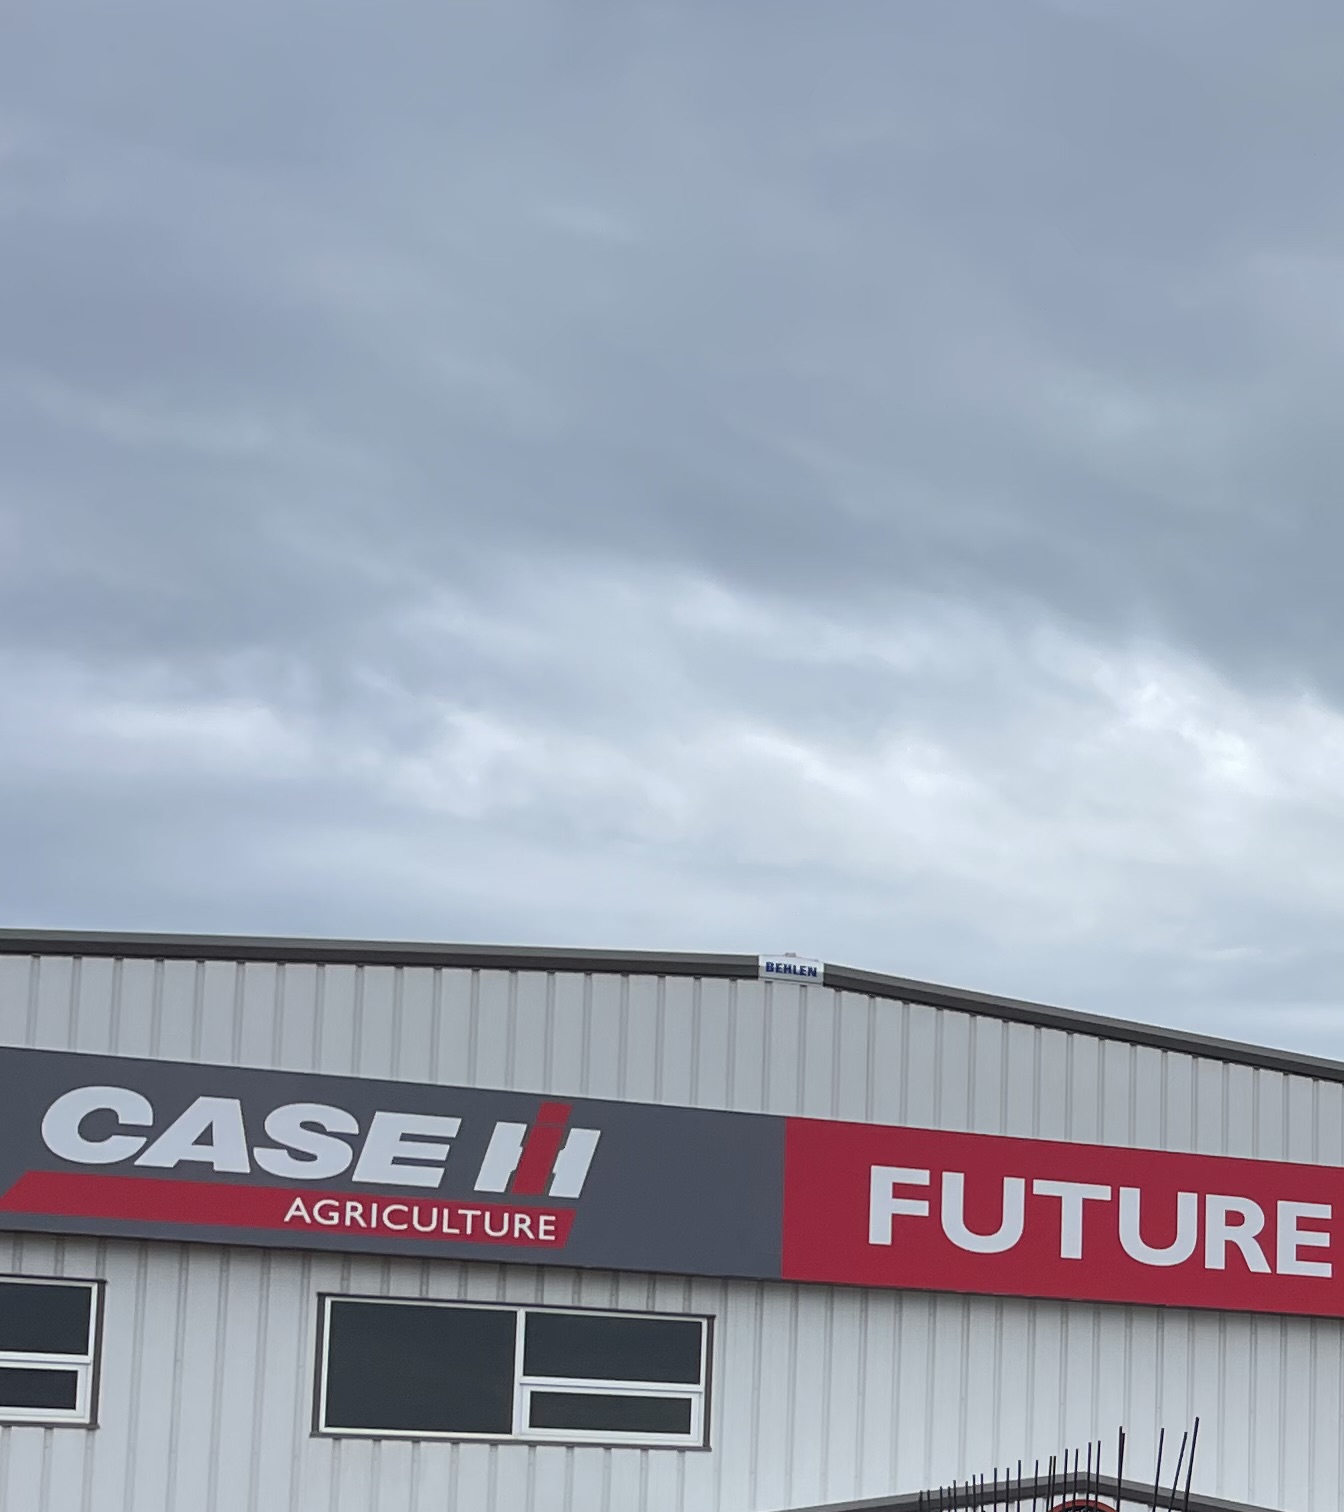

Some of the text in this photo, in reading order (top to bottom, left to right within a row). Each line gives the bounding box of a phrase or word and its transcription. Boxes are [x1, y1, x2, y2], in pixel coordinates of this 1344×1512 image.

[765, 961, 817, 977] BEHLEN
[41, 1085, 463, 1189] CASE
[284, 1196, 556, 1241] AGRICULTURE
[867, 1164, 1334, 1279] FUTURE
